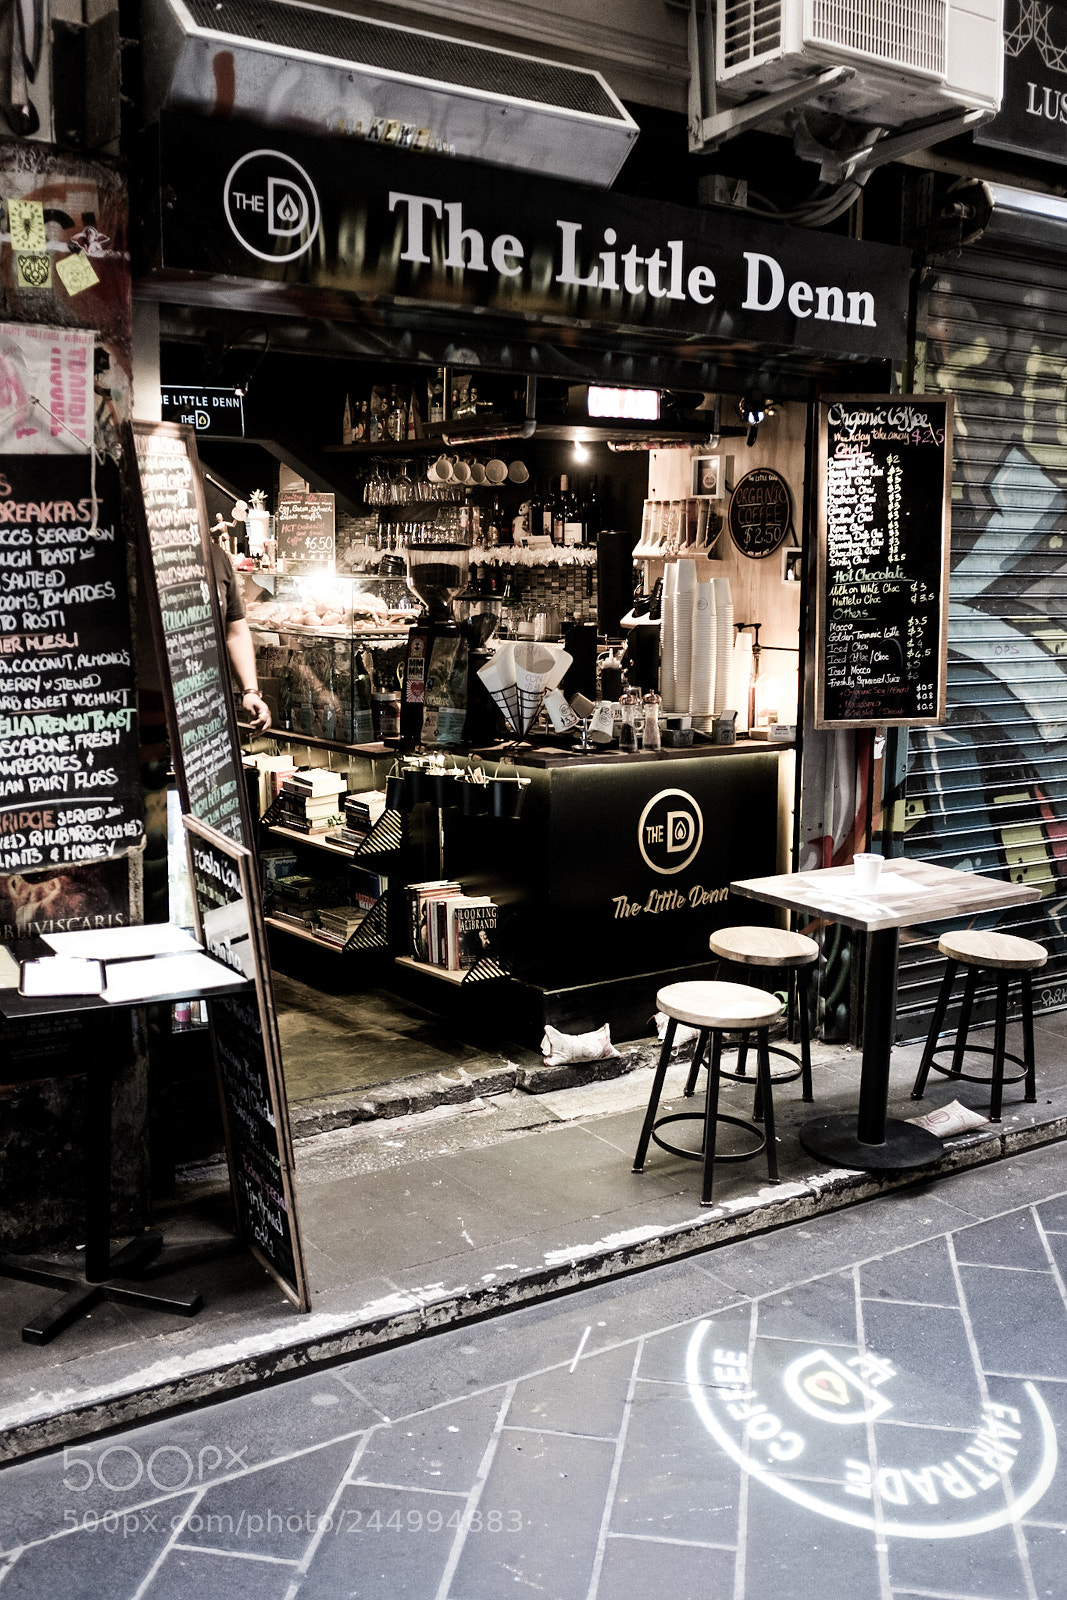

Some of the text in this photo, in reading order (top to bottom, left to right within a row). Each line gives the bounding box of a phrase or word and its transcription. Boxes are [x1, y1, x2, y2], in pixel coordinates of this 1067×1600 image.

[1026, 82, 1067, 124] LUS
[233, 192, 265, 214] THE
[388, 191, 877, 328] The Little Denn
[173, 395, 208, 406] LITTLE
[213, 397, 240, 408] DENN
[181, 414, 195, 424] THE
[887, 405, 931, 432] Coffee
[737, 505, 784, 525] COFFEE
[35, 527, 90, 546] SERVED
[743, 525, 782, 547] $2.50
[36, 547, 78, 566] TOAST
[1, 569, 66, 593] SAUTEED
[832, 564, 907, 584] Hot Chocolate
[22, 610, 66, 631] ROSTI
[26, 632, 79, 652] MUESLI
[30, 692, 67, 711] SWEET
[72, 688, 132, 708] YOGHURT
[88, 708, 138, 732] TOAST
[74, 729, 121, 750] FRESH
[28, 772, 68, 794] FAIRY
[74, 767, 119, 790] FLOSS
[57, 806, 104, 826] SERVED
[646, 825, 664, 844] THE
[64, 840, 116, 861] HONEY
[612, 885, 729, 919] The Little Denn
[459, 907, 497, 920] LOOKING
[460, 918, 497, 931] ALIBRANDI
[712, 1348, 805, 1461] COFFEE
[845, 1402, 1023, 1506] FAIRTRADE
